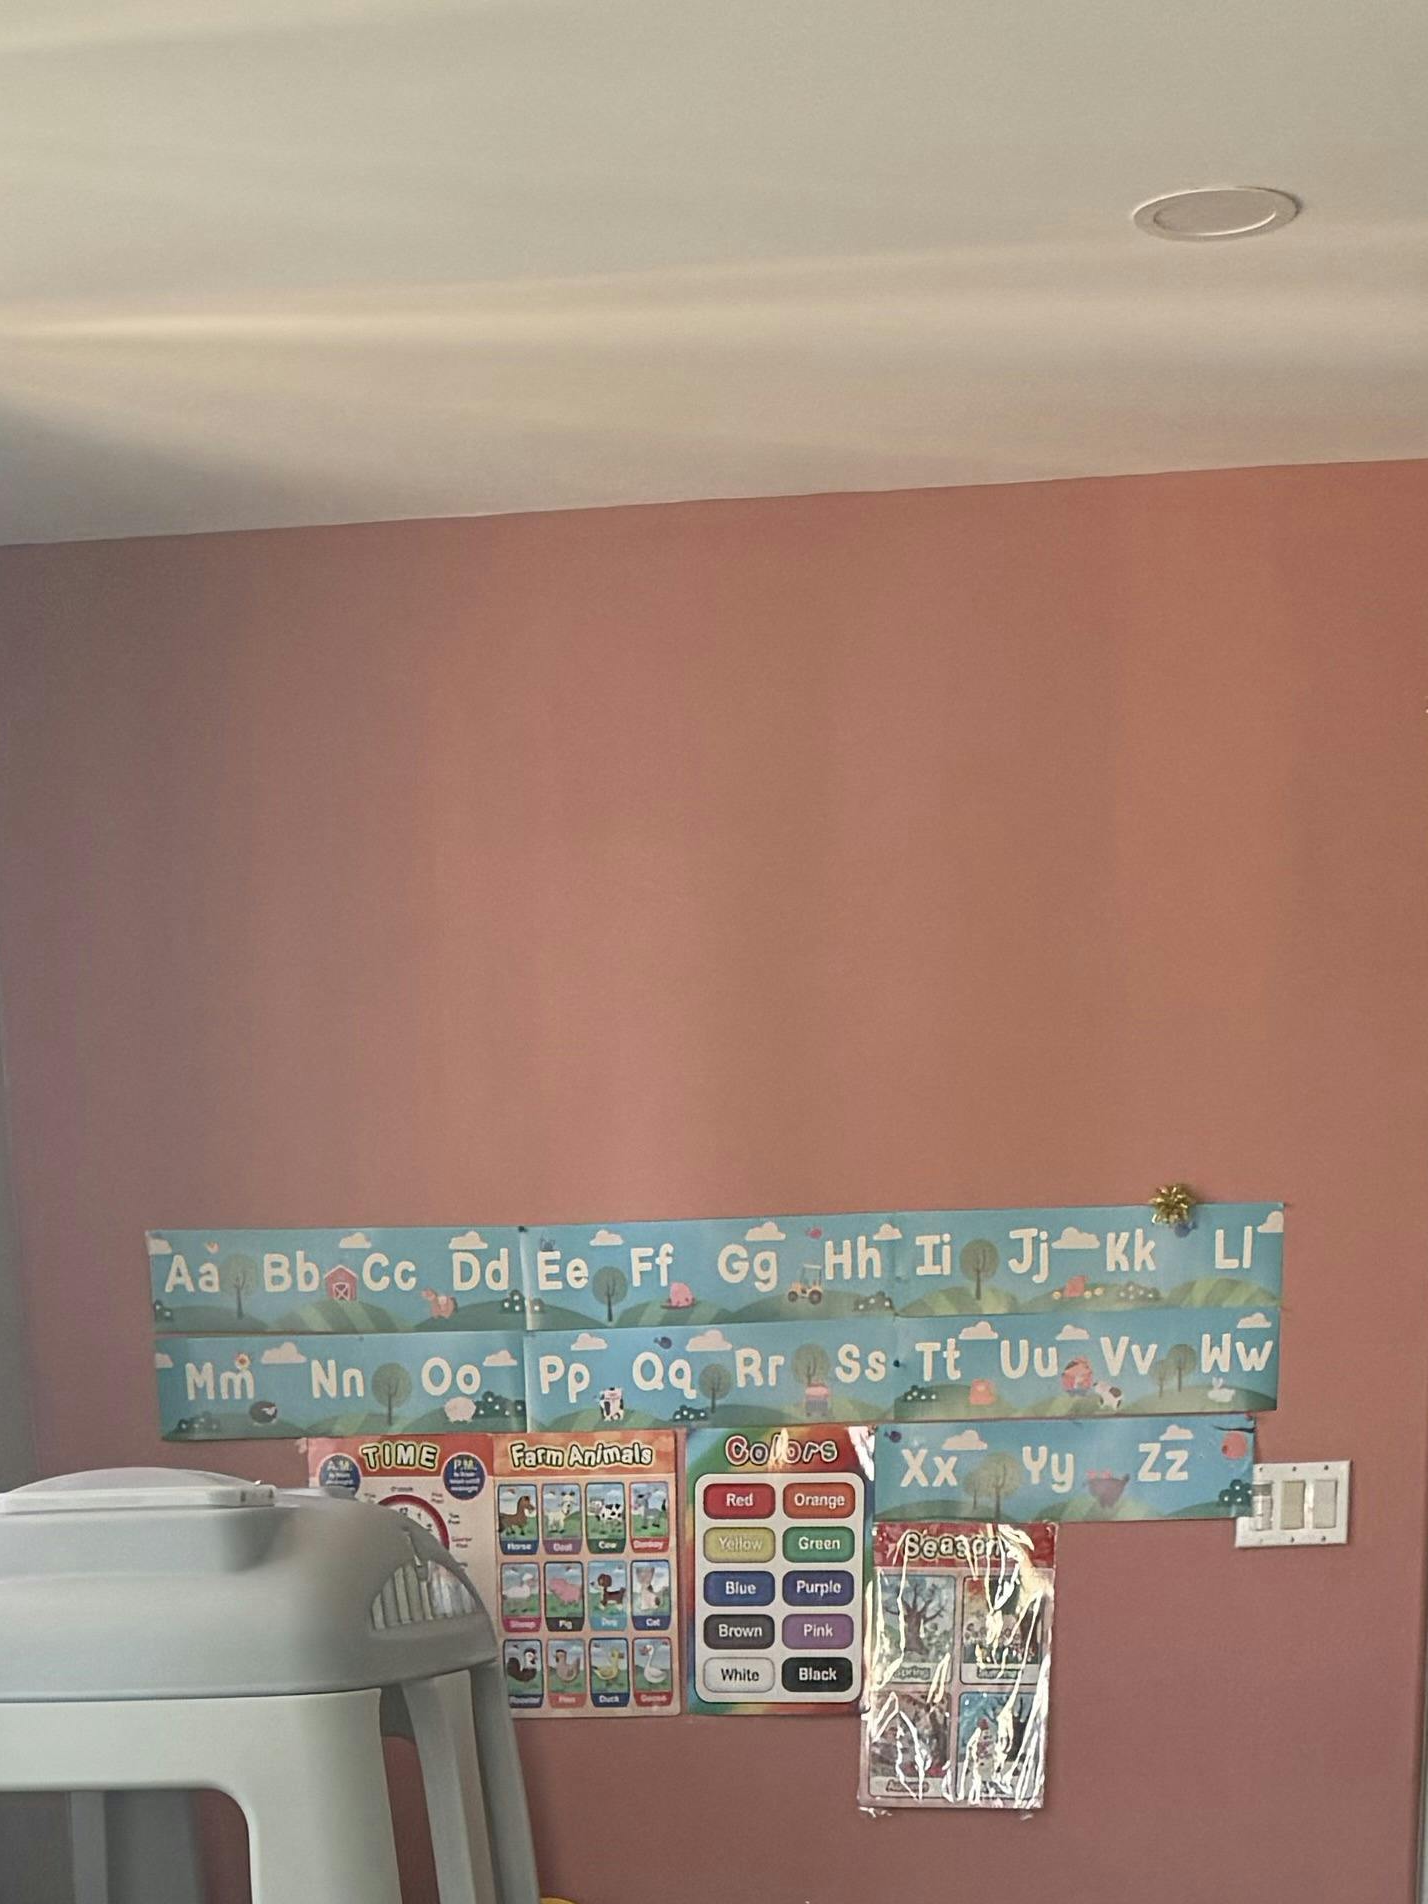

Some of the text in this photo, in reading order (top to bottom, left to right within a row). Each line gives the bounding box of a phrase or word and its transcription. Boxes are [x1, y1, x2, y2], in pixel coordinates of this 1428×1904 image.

[164, 1225, 1253, 1293] Aa Bb Cc Dd Ee Ff Gg Hh Ii Jj Kk Ll
[185, 1333, 1273, 1403] Mm Nn Oo Pp Qq Rr Ss Tt Uu Vv Ww
[361, 1444, 437, 1470] TIME
[510, 1441, 653, 1469] Farm Animals
[725, 1433, 839, 1466] Colors
[900, 1442, 1189, 1494] Xx Yy Zz
[726, 1493, 754, 1507] Red
[794, 1493, 845, 1509] Orange
[719, 1537, 763, 1551] Yellow
[798, 1537, 840, 1550] Green
[903, 1531, 1009, 1559] Season
[725, 1581, 756, 1595] Blue
[796, 1580, 841, 1597] Purple
[718, 1624, 763, 1637] Brown
[803, 1624, 833, 1637] Pink
[721, 1668, 760, 1682] White
[798, 1667, 837, 1682] Black
